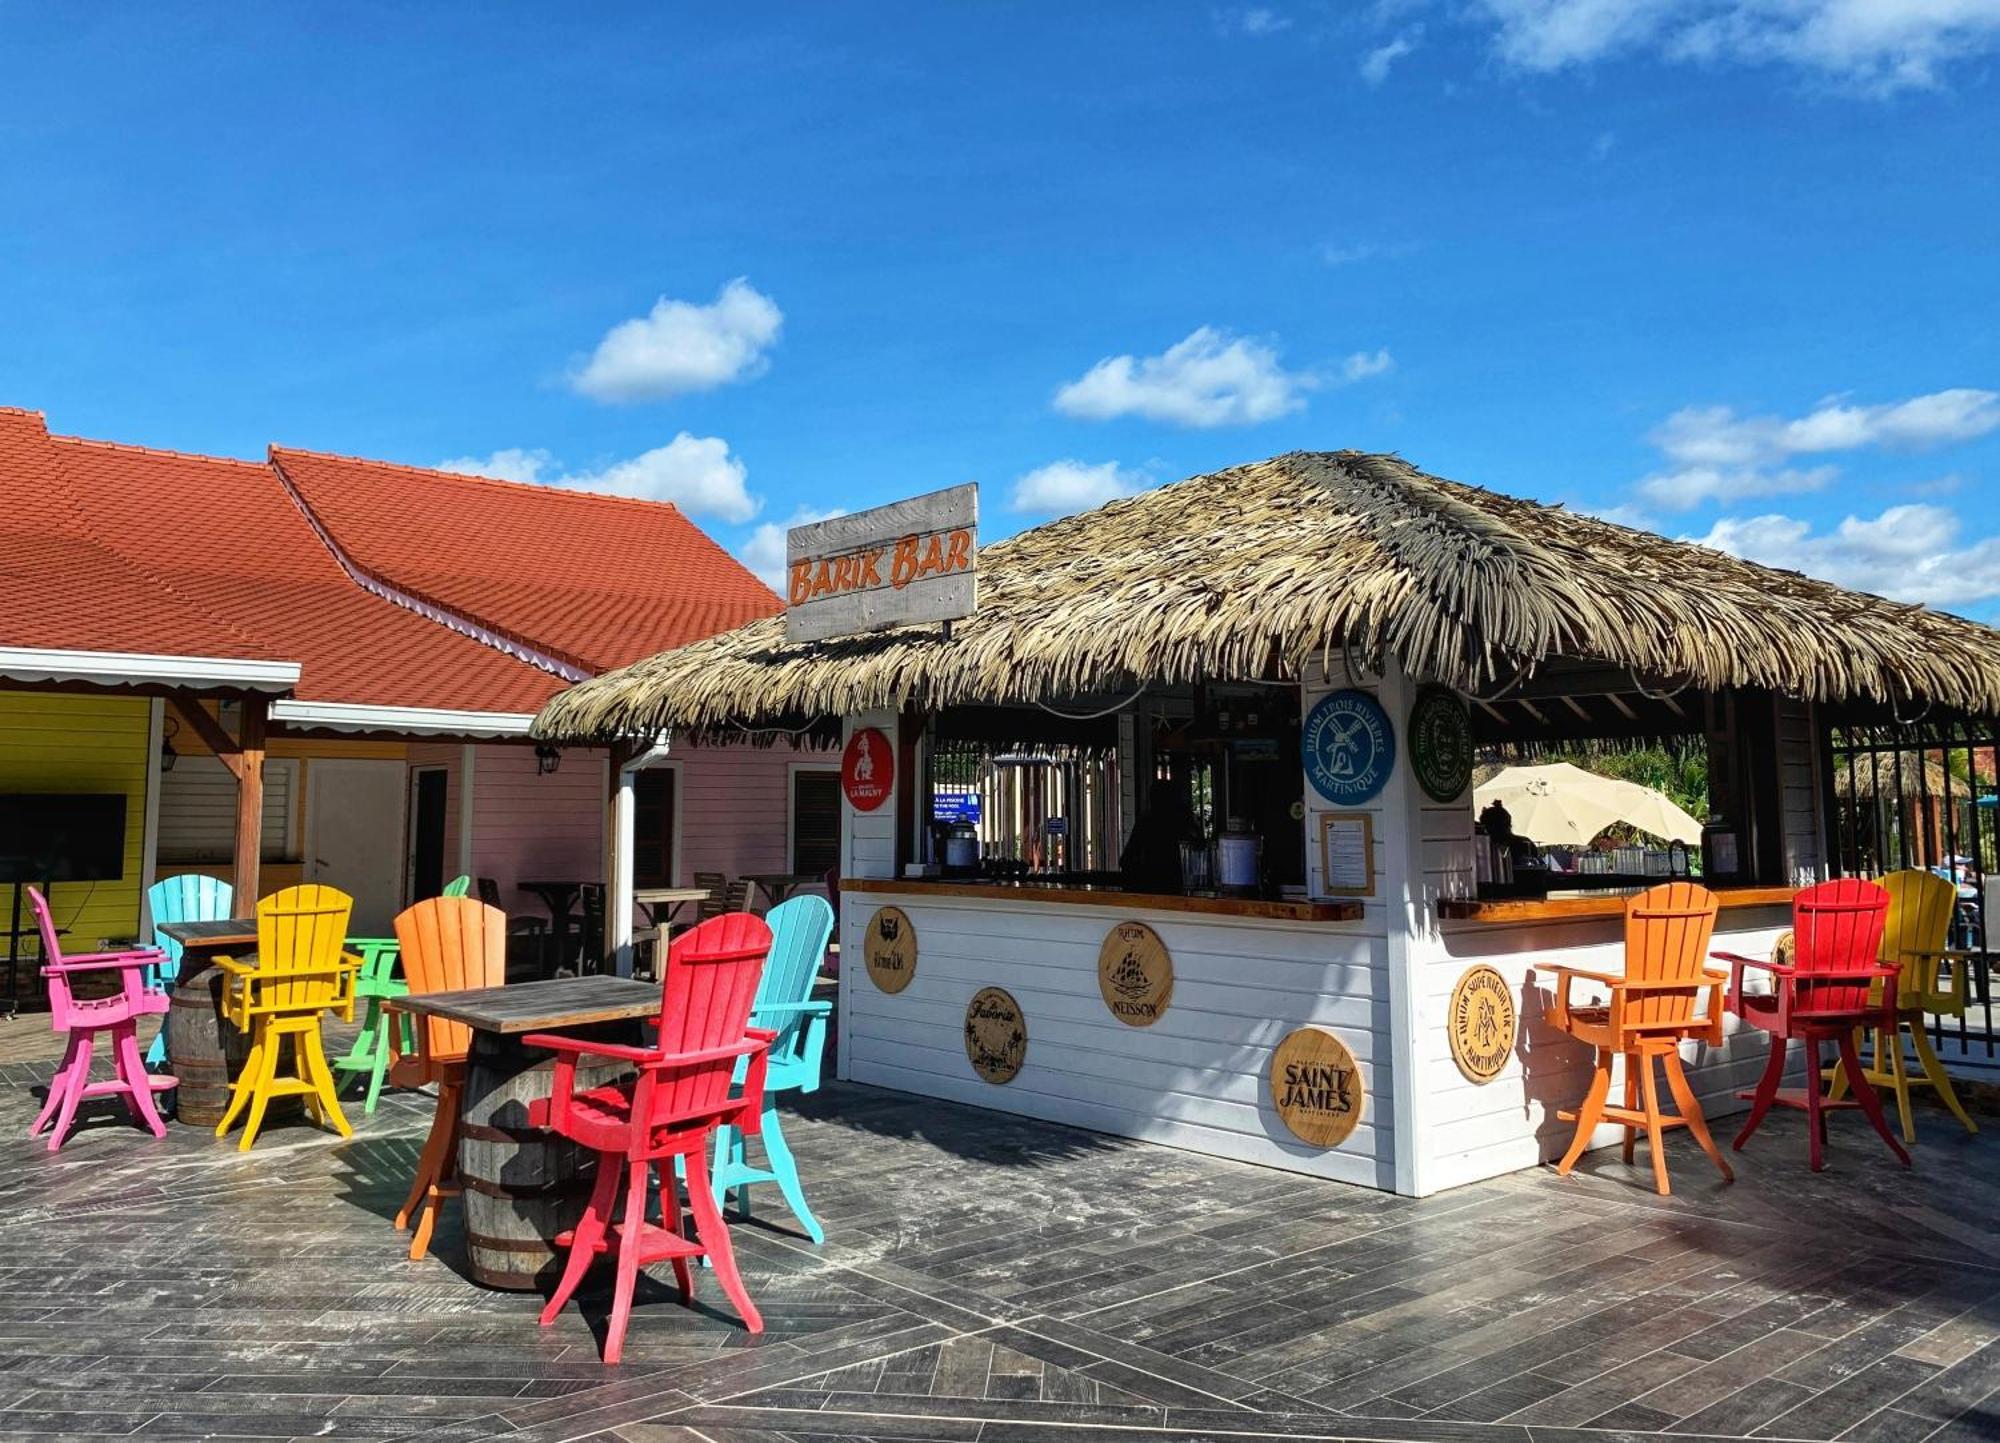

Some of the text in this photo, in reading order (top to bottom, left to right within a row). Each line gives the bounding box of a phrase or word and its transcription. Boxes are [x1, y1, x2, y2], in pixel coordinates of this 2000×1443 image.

[790, 529, 970, 606] BARIK BAR
[1312, 765, 1378, 794] MARTINIQUE
[1112, 1001, 1157, 1017] NEISSON
[1285, 1064, 1348, 1090] SAINT
[1280, 1086, 1351, 1112] JAMES
